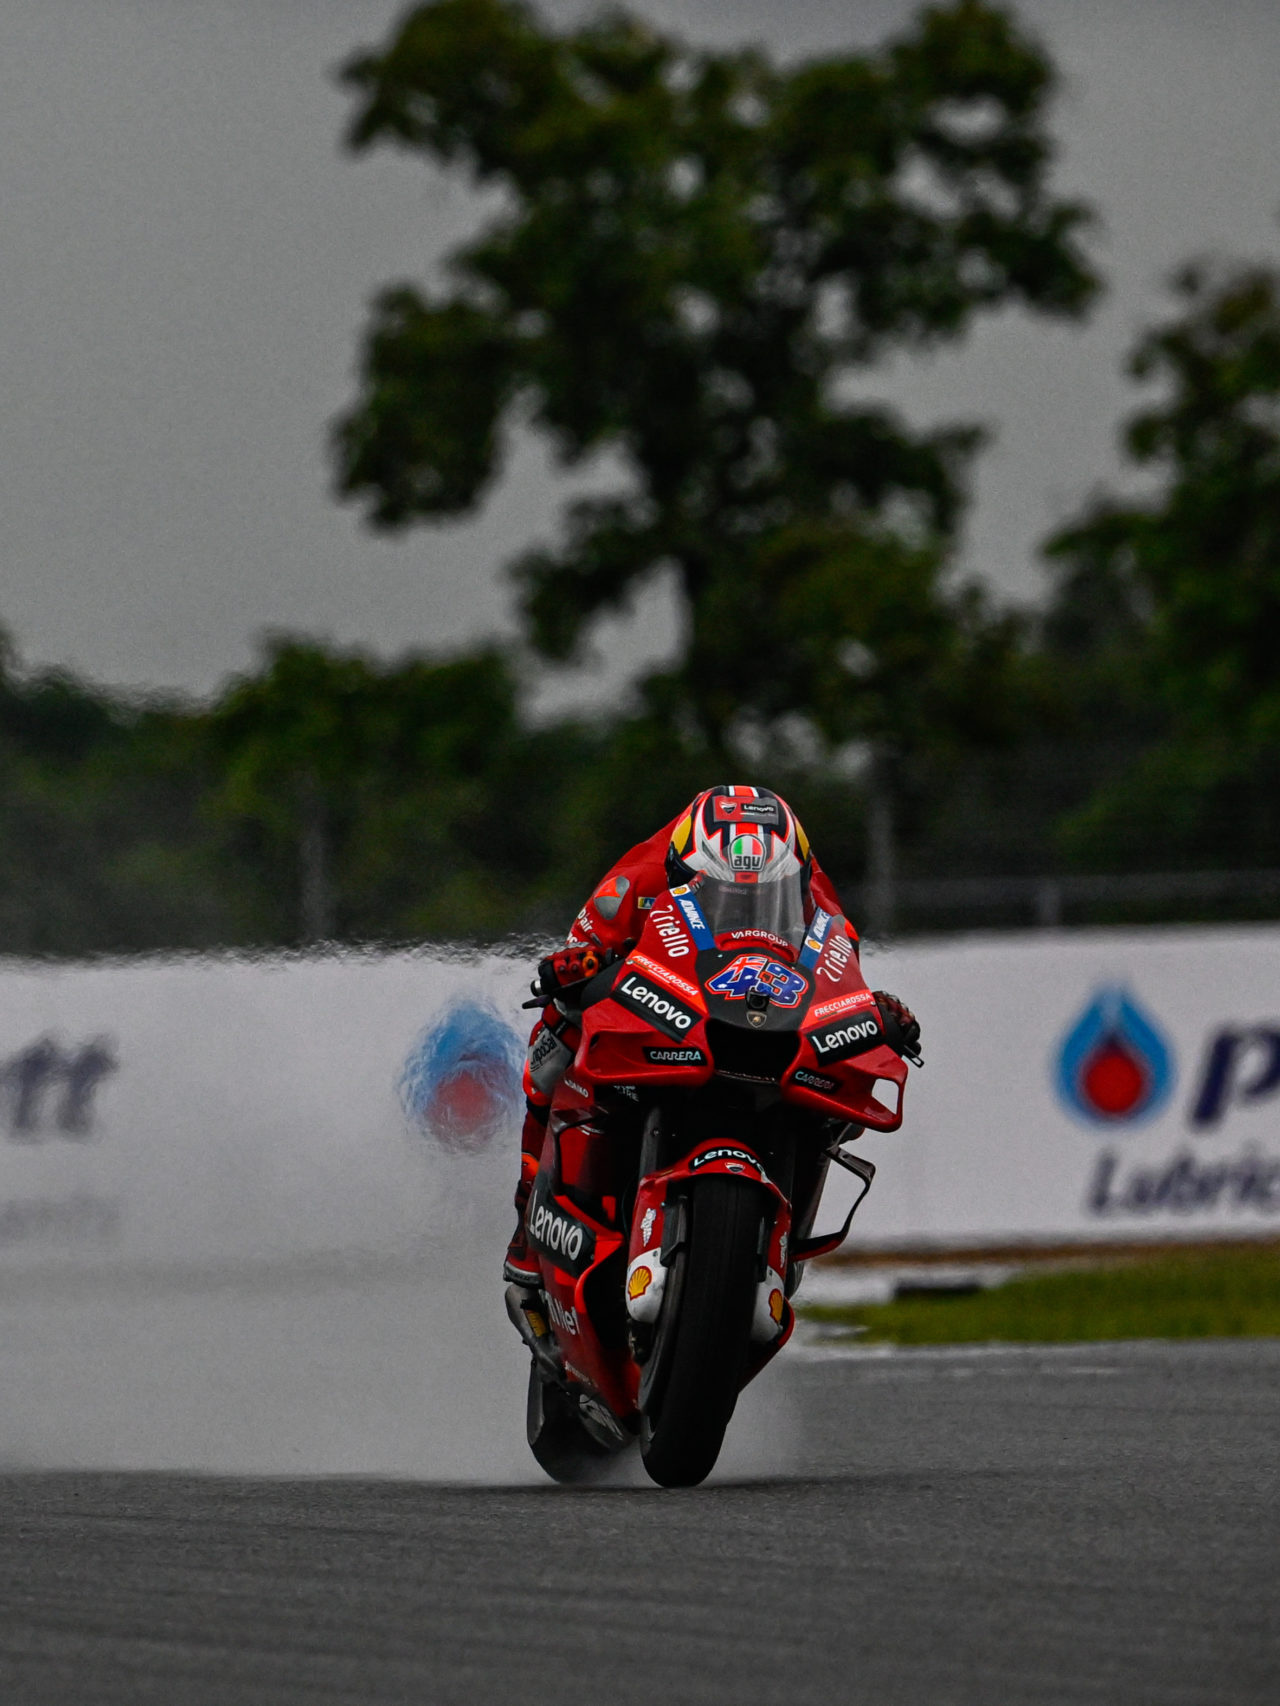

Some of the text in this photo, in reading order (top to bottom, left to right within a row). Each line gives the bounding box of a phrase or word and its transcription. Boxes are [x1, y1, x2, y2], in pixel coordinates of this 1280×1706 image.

[706, 954, 808, 1007] 43
[620, 976, 692, 1029] Lenovo
[814, 993, 871, 1018] FRECCIAROSSA
[649, 1050, 702, 1061] CARRERA
[811, 1020, 878, 1054] Lenovo
[530, 1189, 584, 1261] Lenovo
